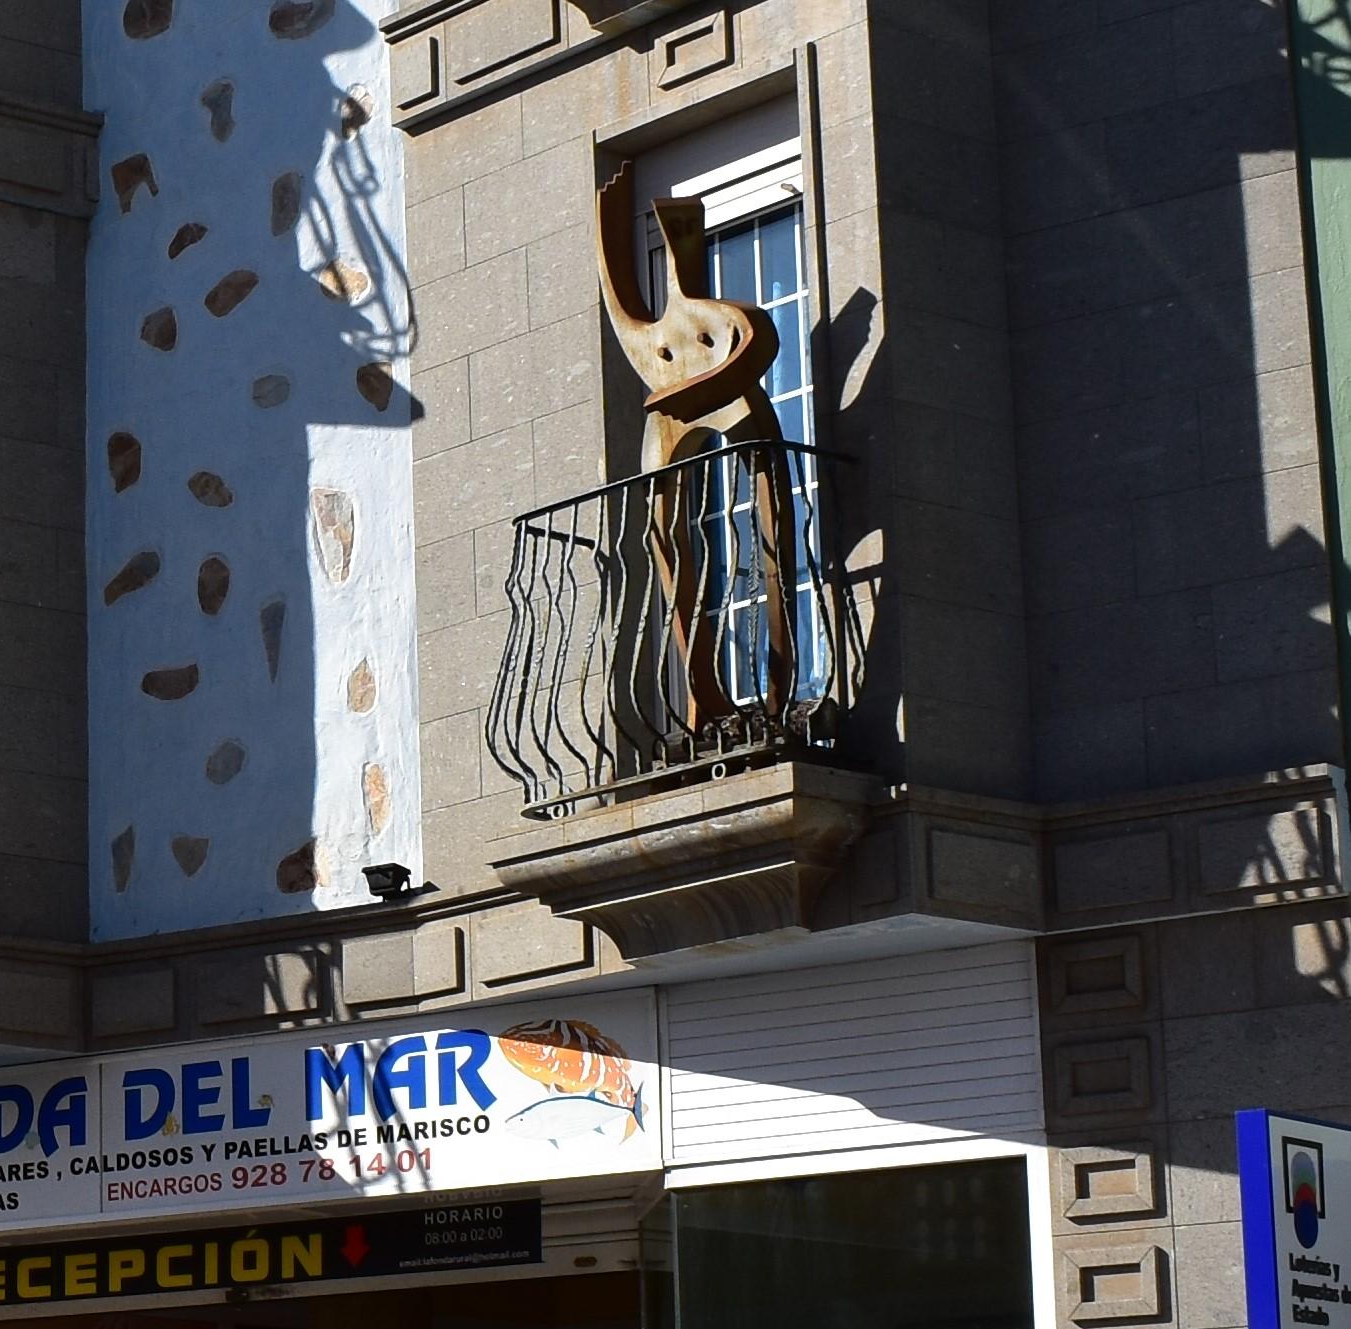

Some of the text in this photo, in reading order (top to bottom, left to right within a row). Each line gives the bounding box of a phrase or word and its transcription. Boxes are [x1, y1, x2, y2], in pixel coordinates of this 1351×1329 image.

[122, 1056, 272, 1142] DEL
[303, 1028, 498, 1122] MAR
[69, 1147, 194, 1176] CALDOSOS
[200, 1143, 217, 1162] Y
[224, 1131, 329, 1160] PAELLAS
[336, 1127, 367, 1149] DE
[376, 1114, 491, 1145] MARISCO
[107, 1146, 432, 1203] ENCARGOS 928 78 14 01
[424, 1205, 504, 1225] HORARIO
[424, 1226, 504, 1246] 08:00 a 02:00
[1333, 1264, 1340, 1283] y
[1292, 1303, 1330, 1327] Estado
